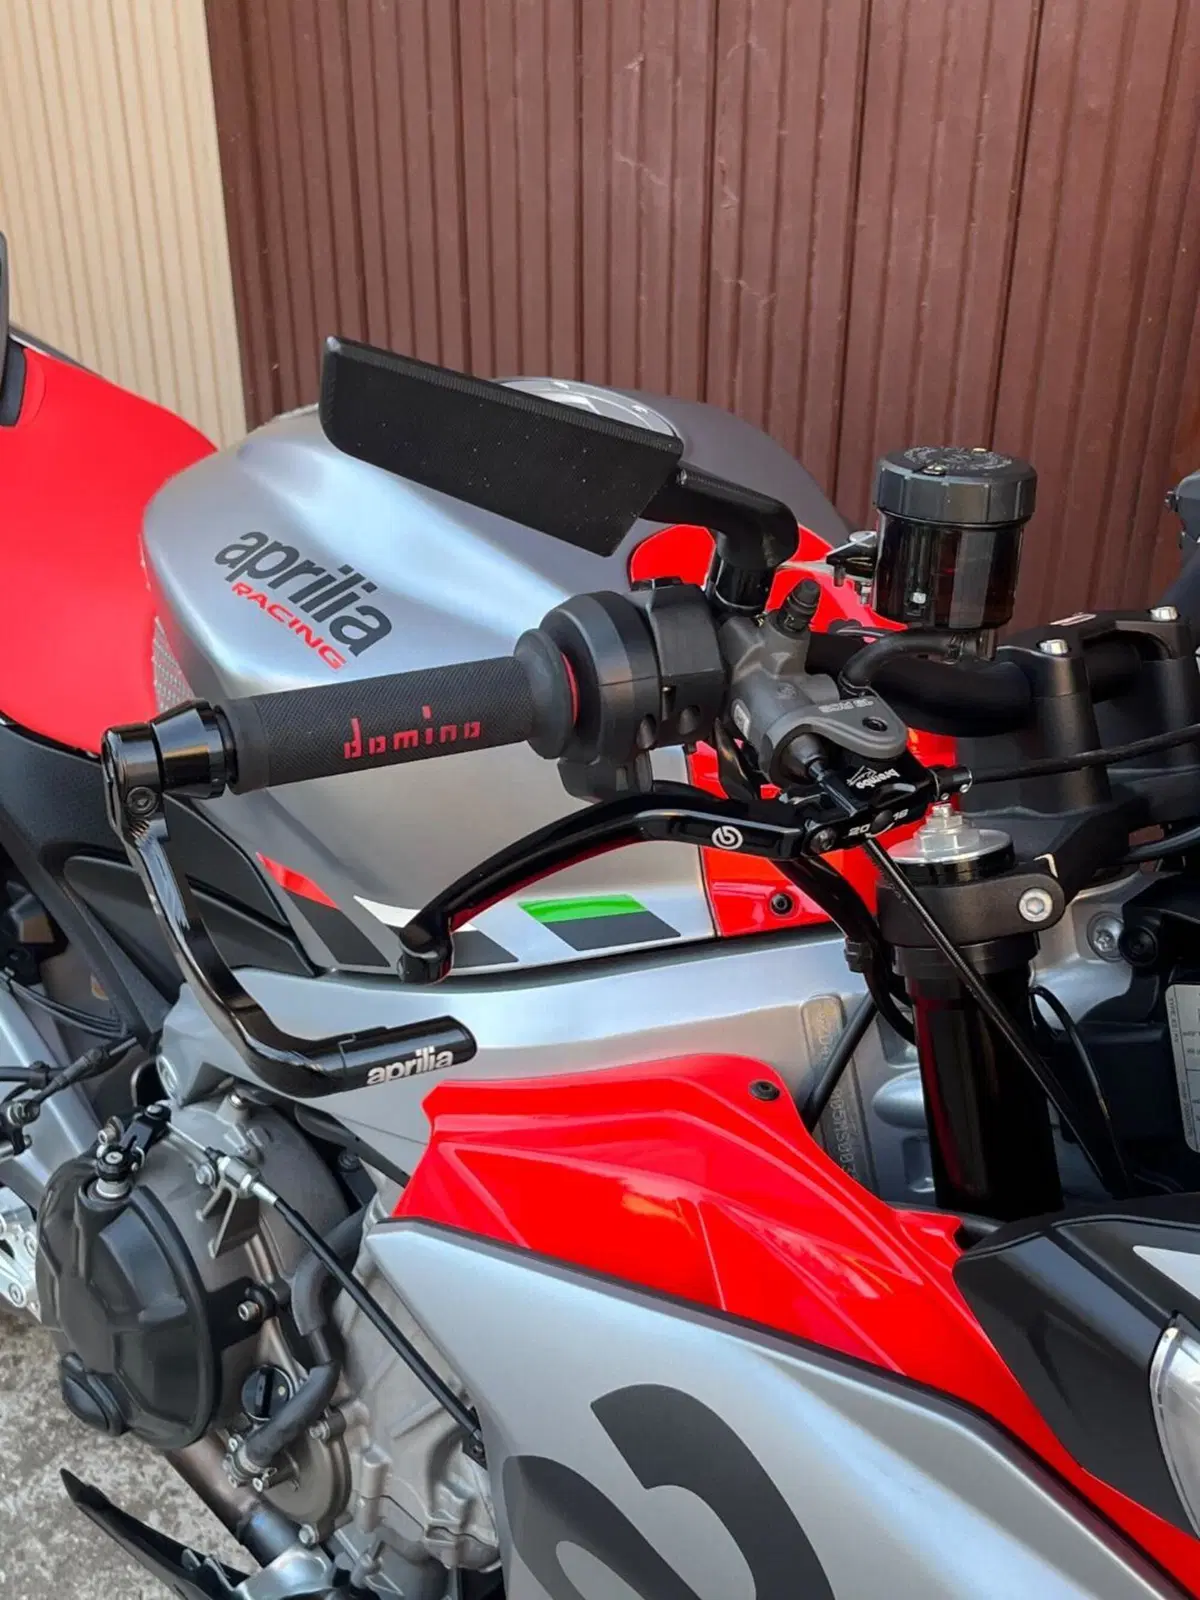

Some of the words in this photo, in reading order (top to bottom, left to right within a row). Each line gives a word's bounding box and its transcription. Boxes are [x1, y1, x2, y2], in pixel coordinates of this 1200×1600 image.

[214, 531, 393, 657] aprilia
[231, 581, 347, 672] RACING
[343, 705, 481, 759] domino
[366, 1045, 454, 1085] aprilia
